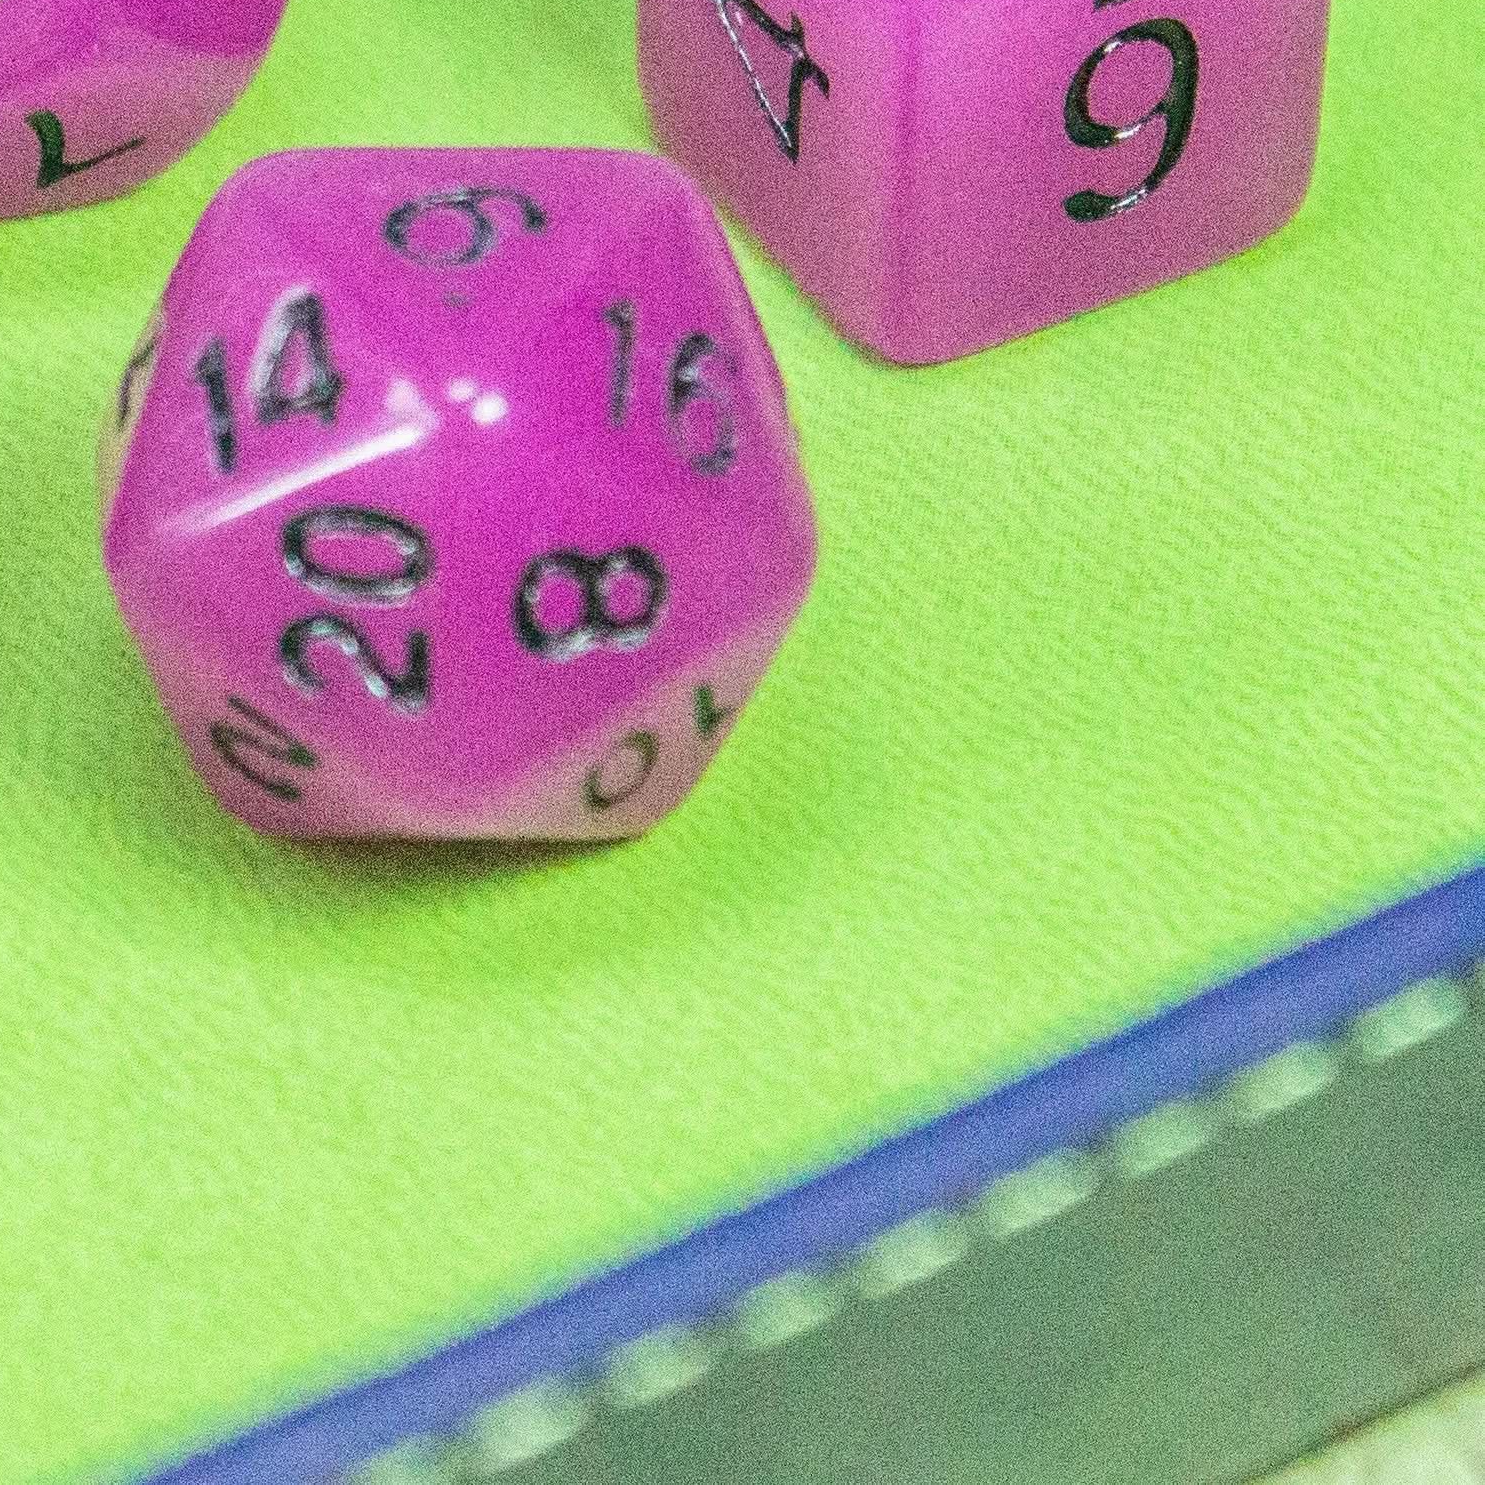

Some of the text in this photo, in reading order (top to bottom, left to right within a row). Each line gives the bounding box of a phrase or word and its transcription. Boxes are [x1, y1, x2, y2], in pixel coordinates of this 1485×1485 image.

[192, 283, 349, 476] 14
[598, 296, 740, 477] 16
[276, 504, 436, 719] 20
[511, 540, 671, 662] 8
